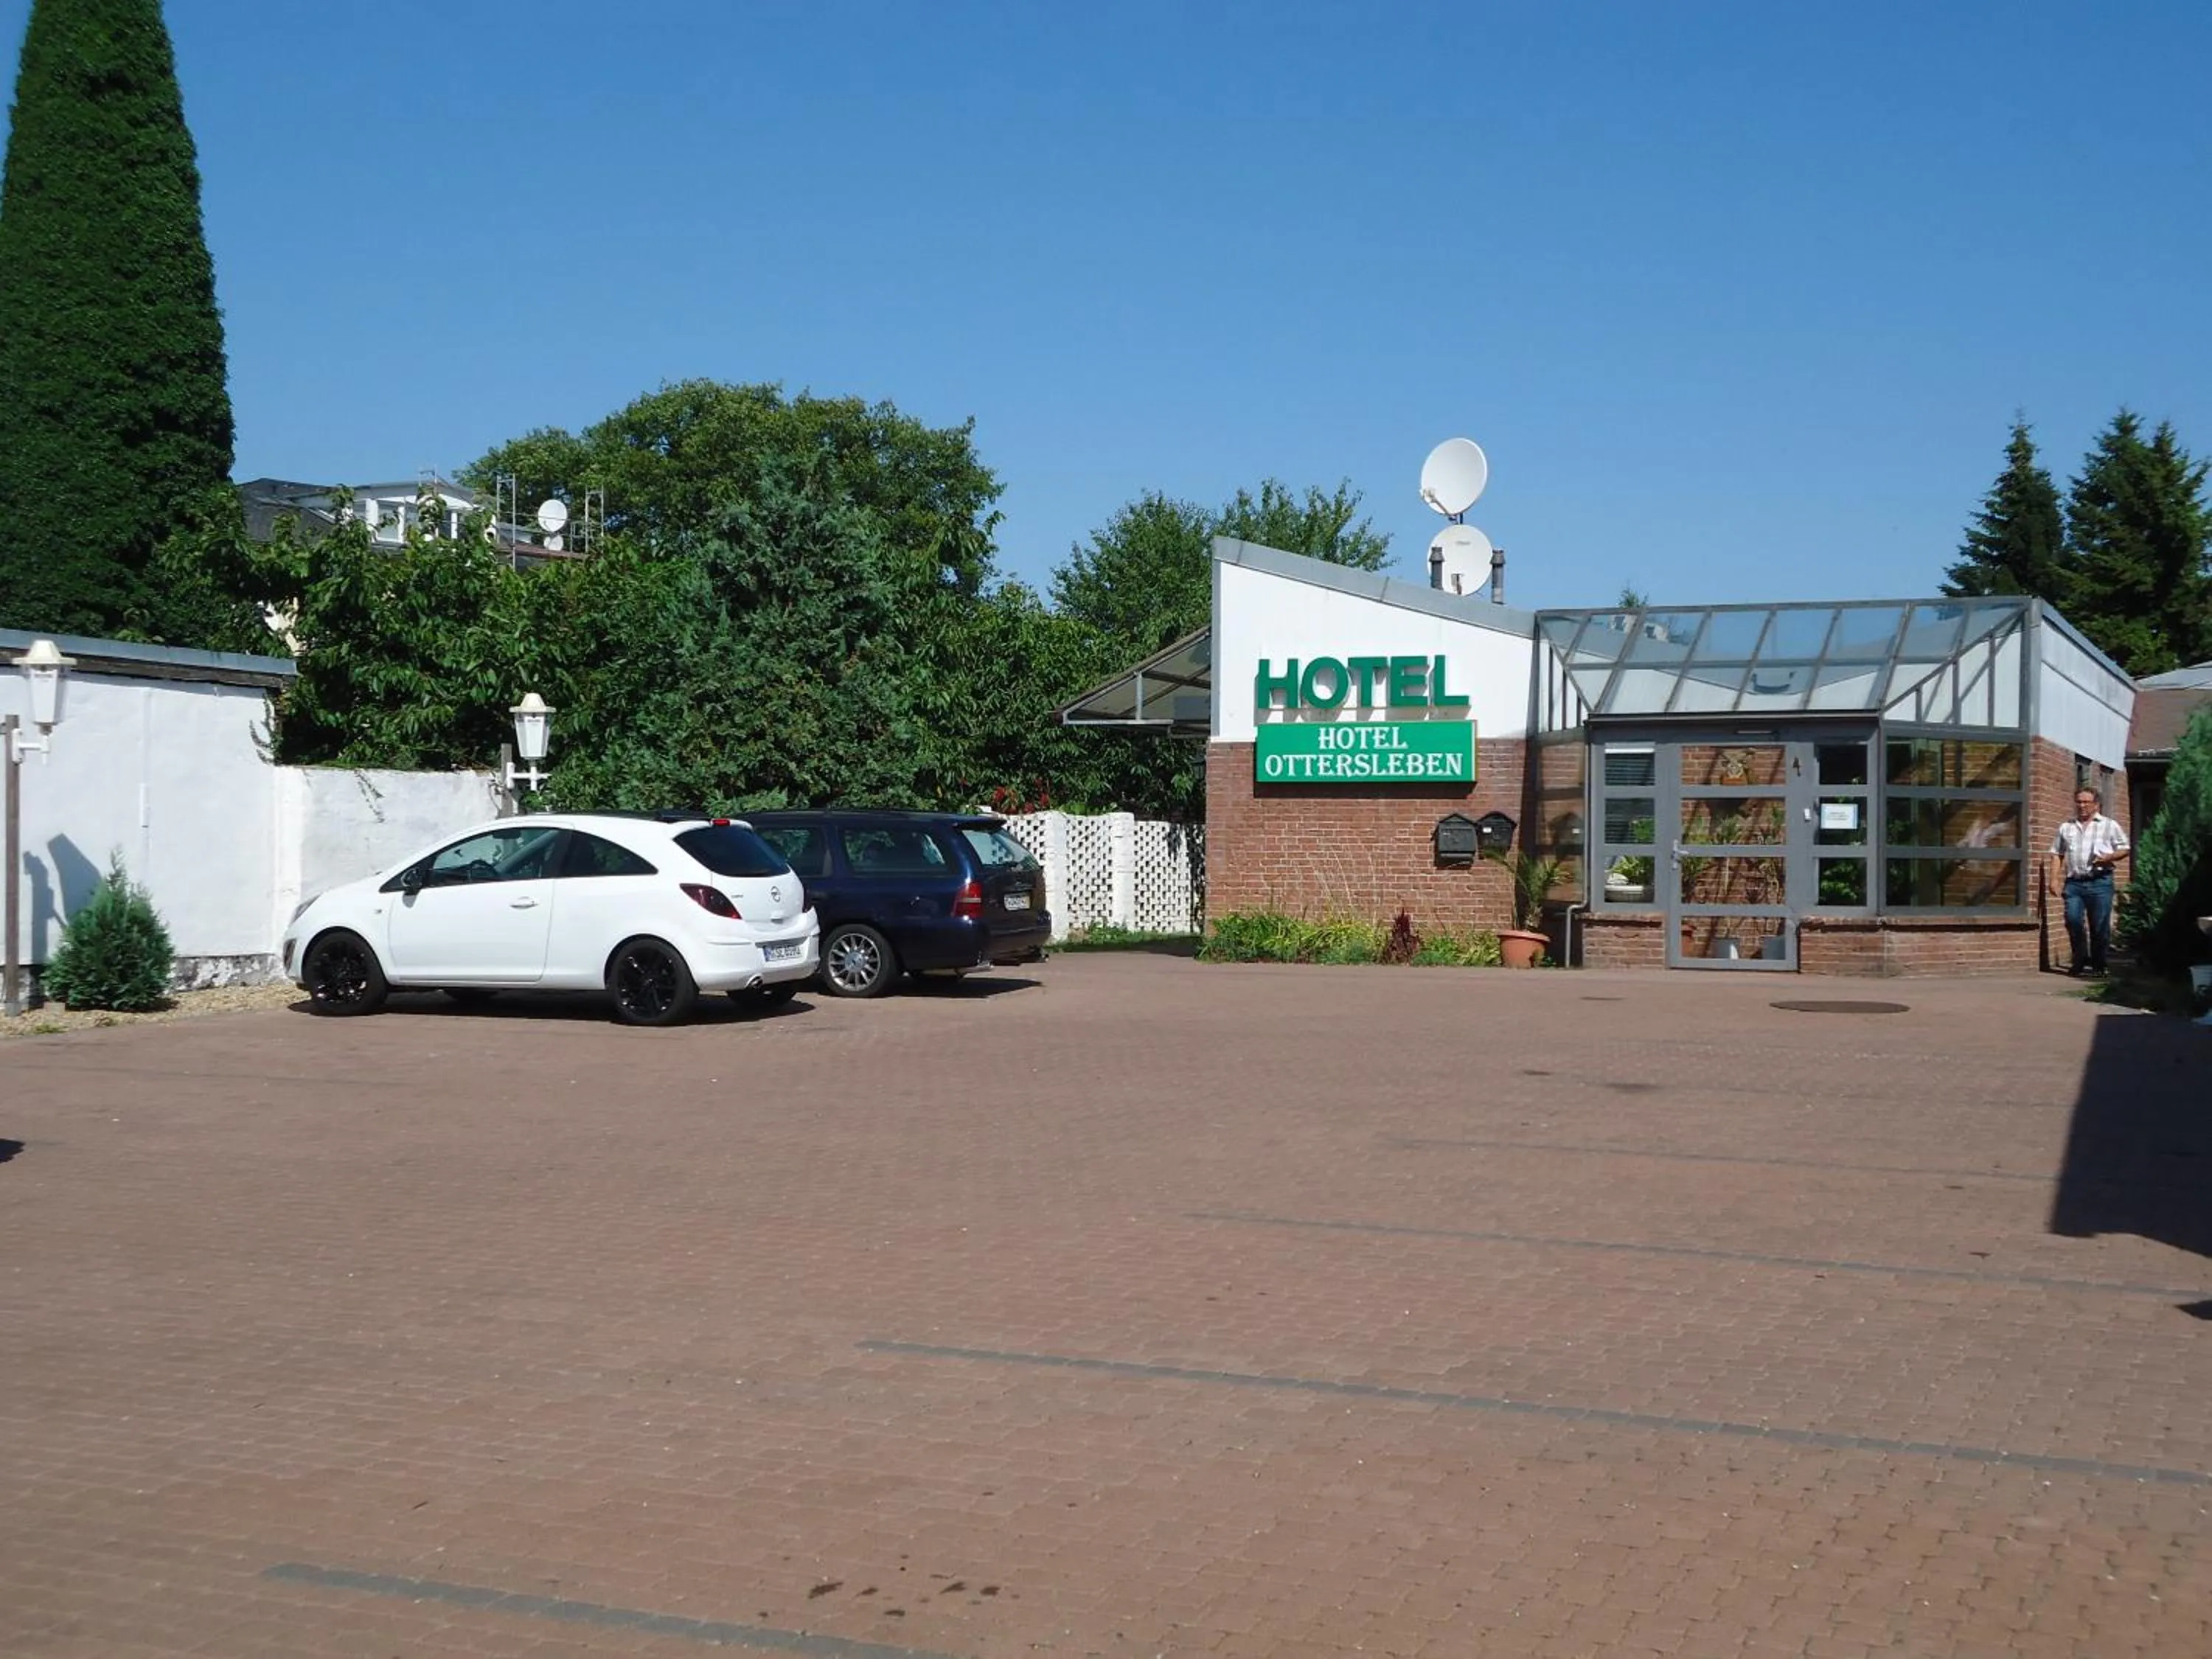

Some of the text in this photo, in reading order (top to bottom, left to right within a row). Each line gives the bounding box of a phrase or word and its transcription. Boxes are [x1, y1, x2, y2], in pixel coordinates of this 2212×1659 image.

[1257, 655, 1470, 709] HOTEL
[1318, 727, 1408, 749] HOTEL
[1265, 753, 1463, 776] OTTERSLEBEN
